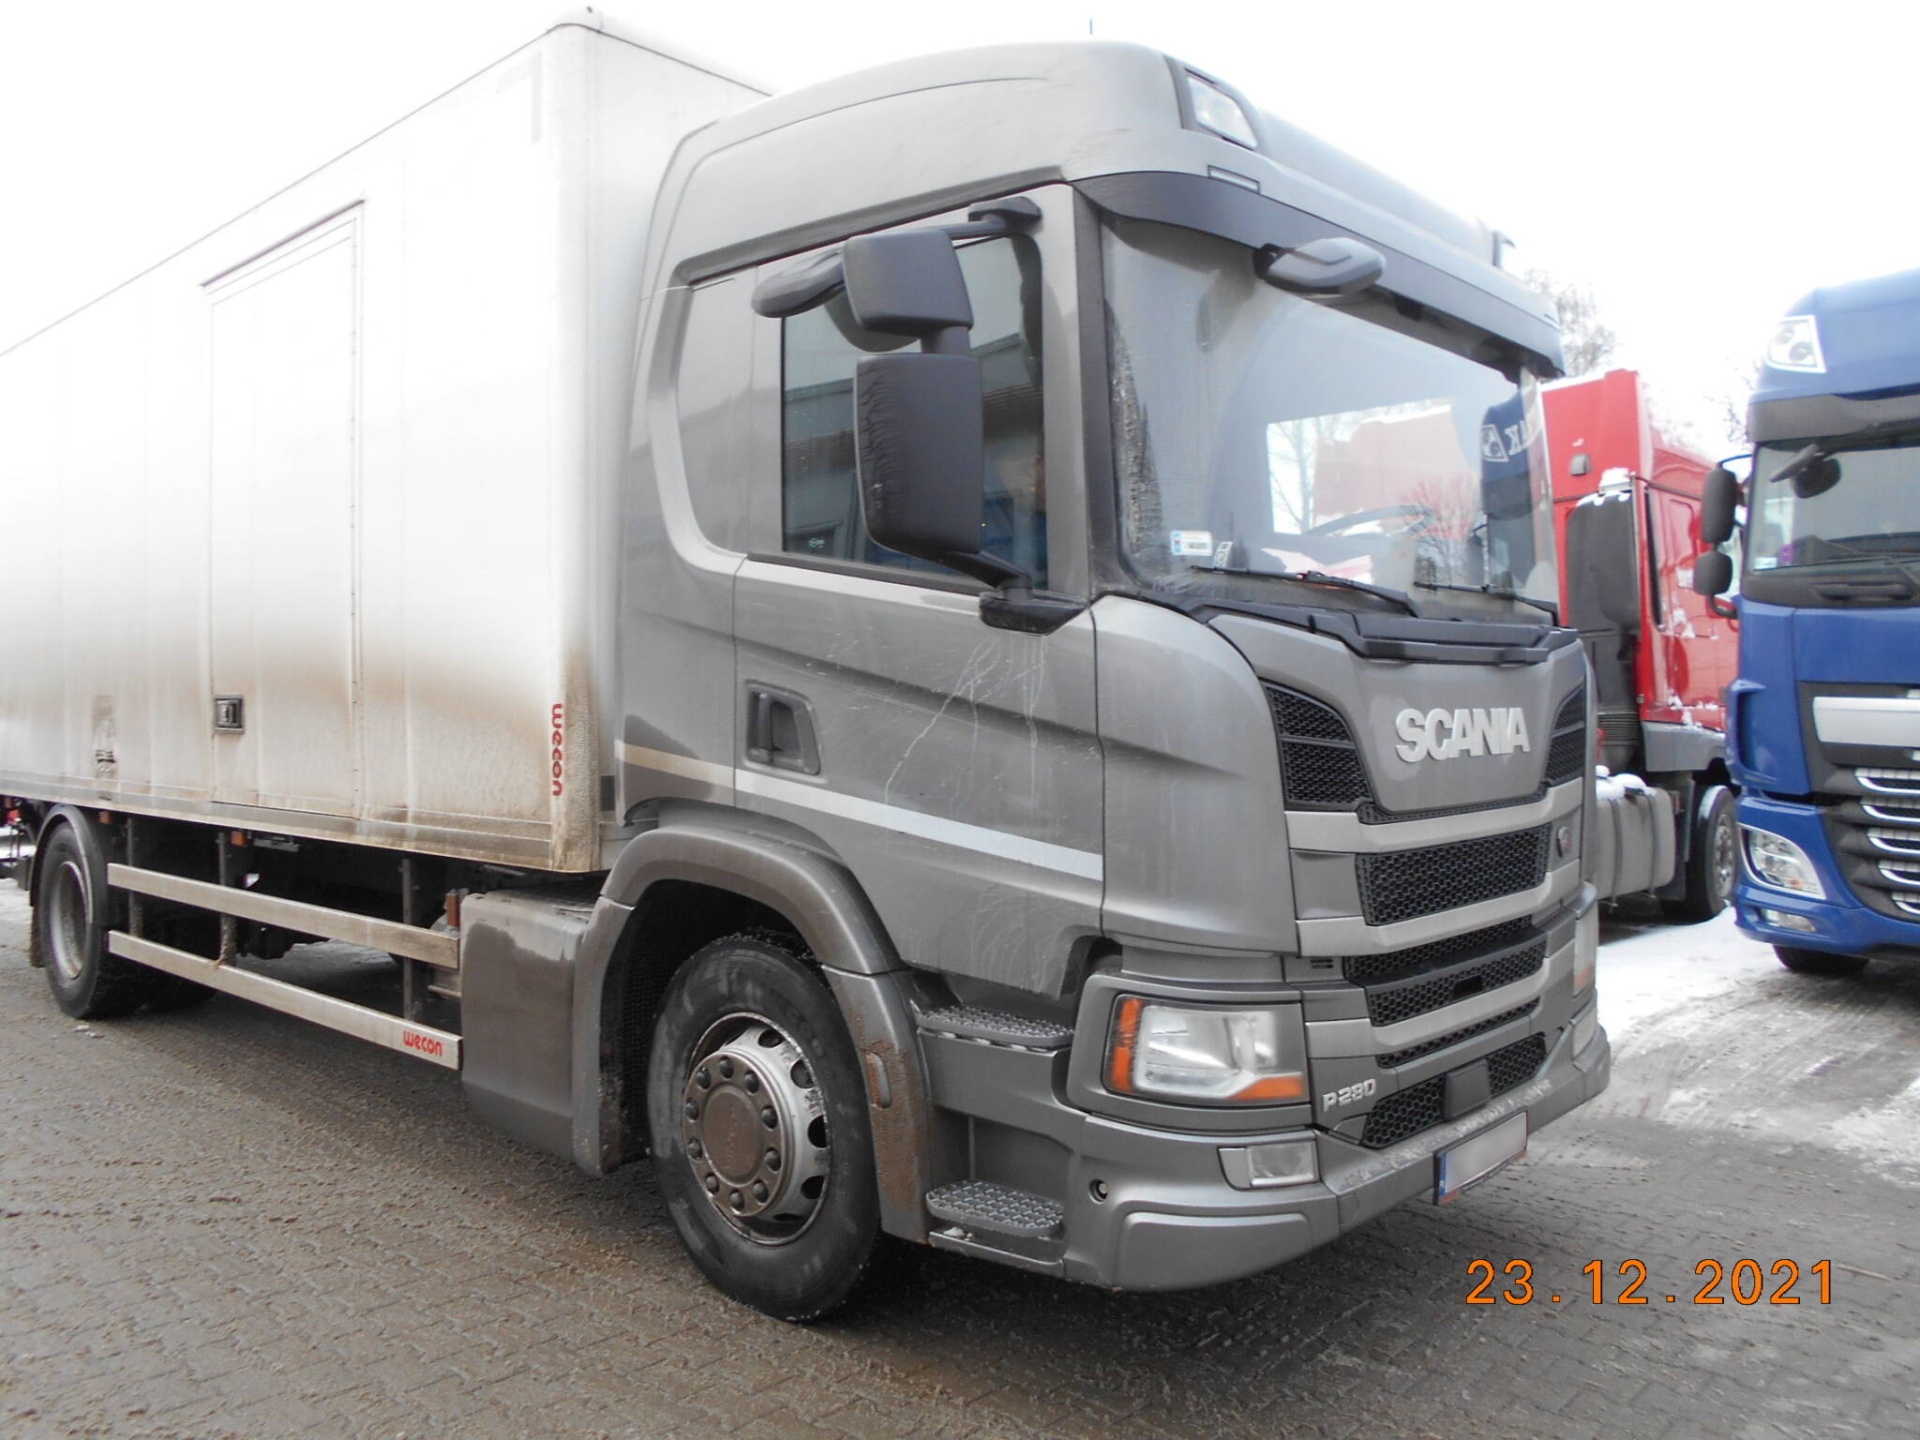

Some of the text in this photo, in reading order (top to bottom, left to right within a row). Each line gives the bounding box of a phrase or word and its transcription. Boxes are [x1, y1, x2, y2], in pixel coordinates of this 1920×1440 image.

[551, 703, 563, 796] wecon
[1395, 707, 1531, 763] SCANIA
[403, 1030, 443, 1057] wecon
